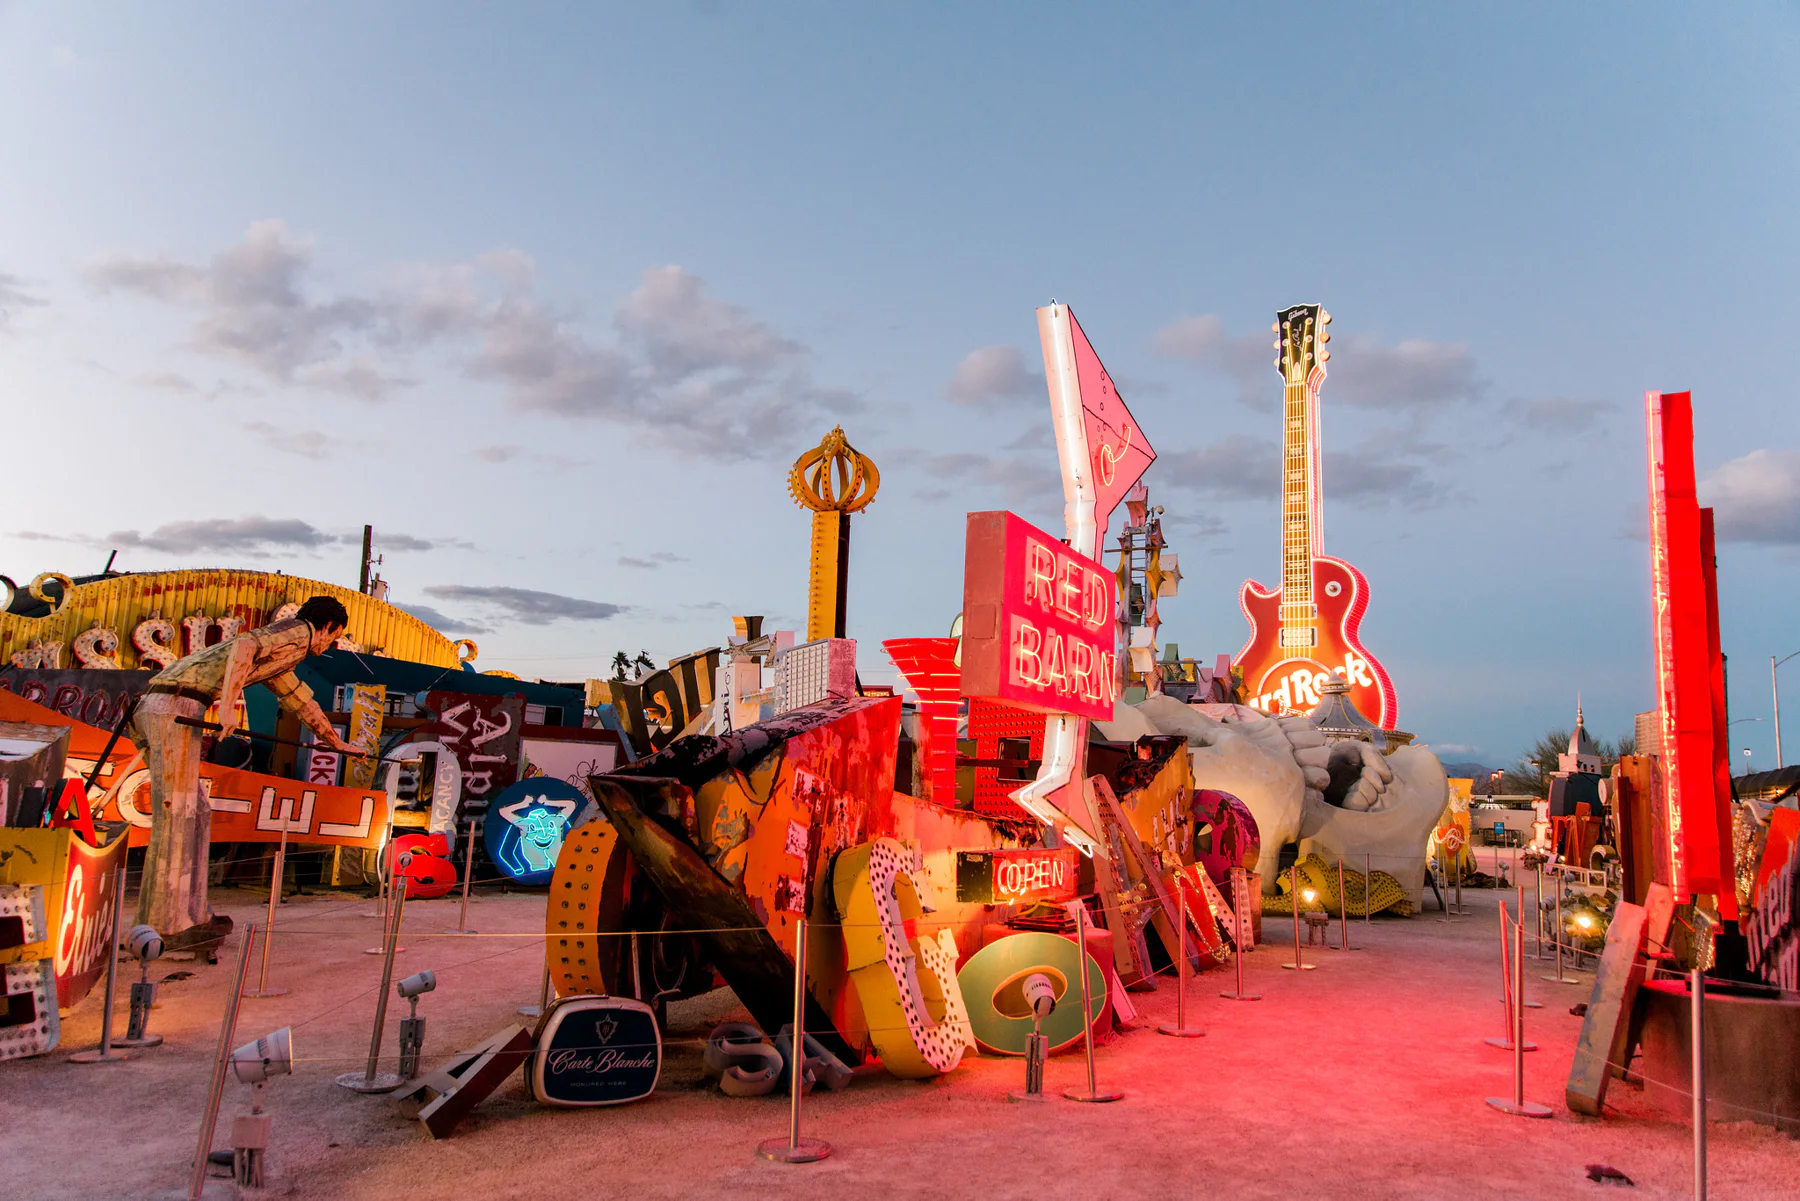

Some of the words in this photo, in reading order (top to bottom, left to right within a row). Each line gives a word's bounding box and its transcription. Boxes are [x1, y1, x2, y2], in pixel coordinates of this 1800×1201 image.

[1024, 536, 1108, 632] RED
[1009, 613, 1117, 708] BARN
[432, 761, 455, 834] ACANCY
[997, 857, 1065, 895] OPEN
[548, 1049, 592, 1075] Carte
[586, 1049, 655, 1073] Blanche
